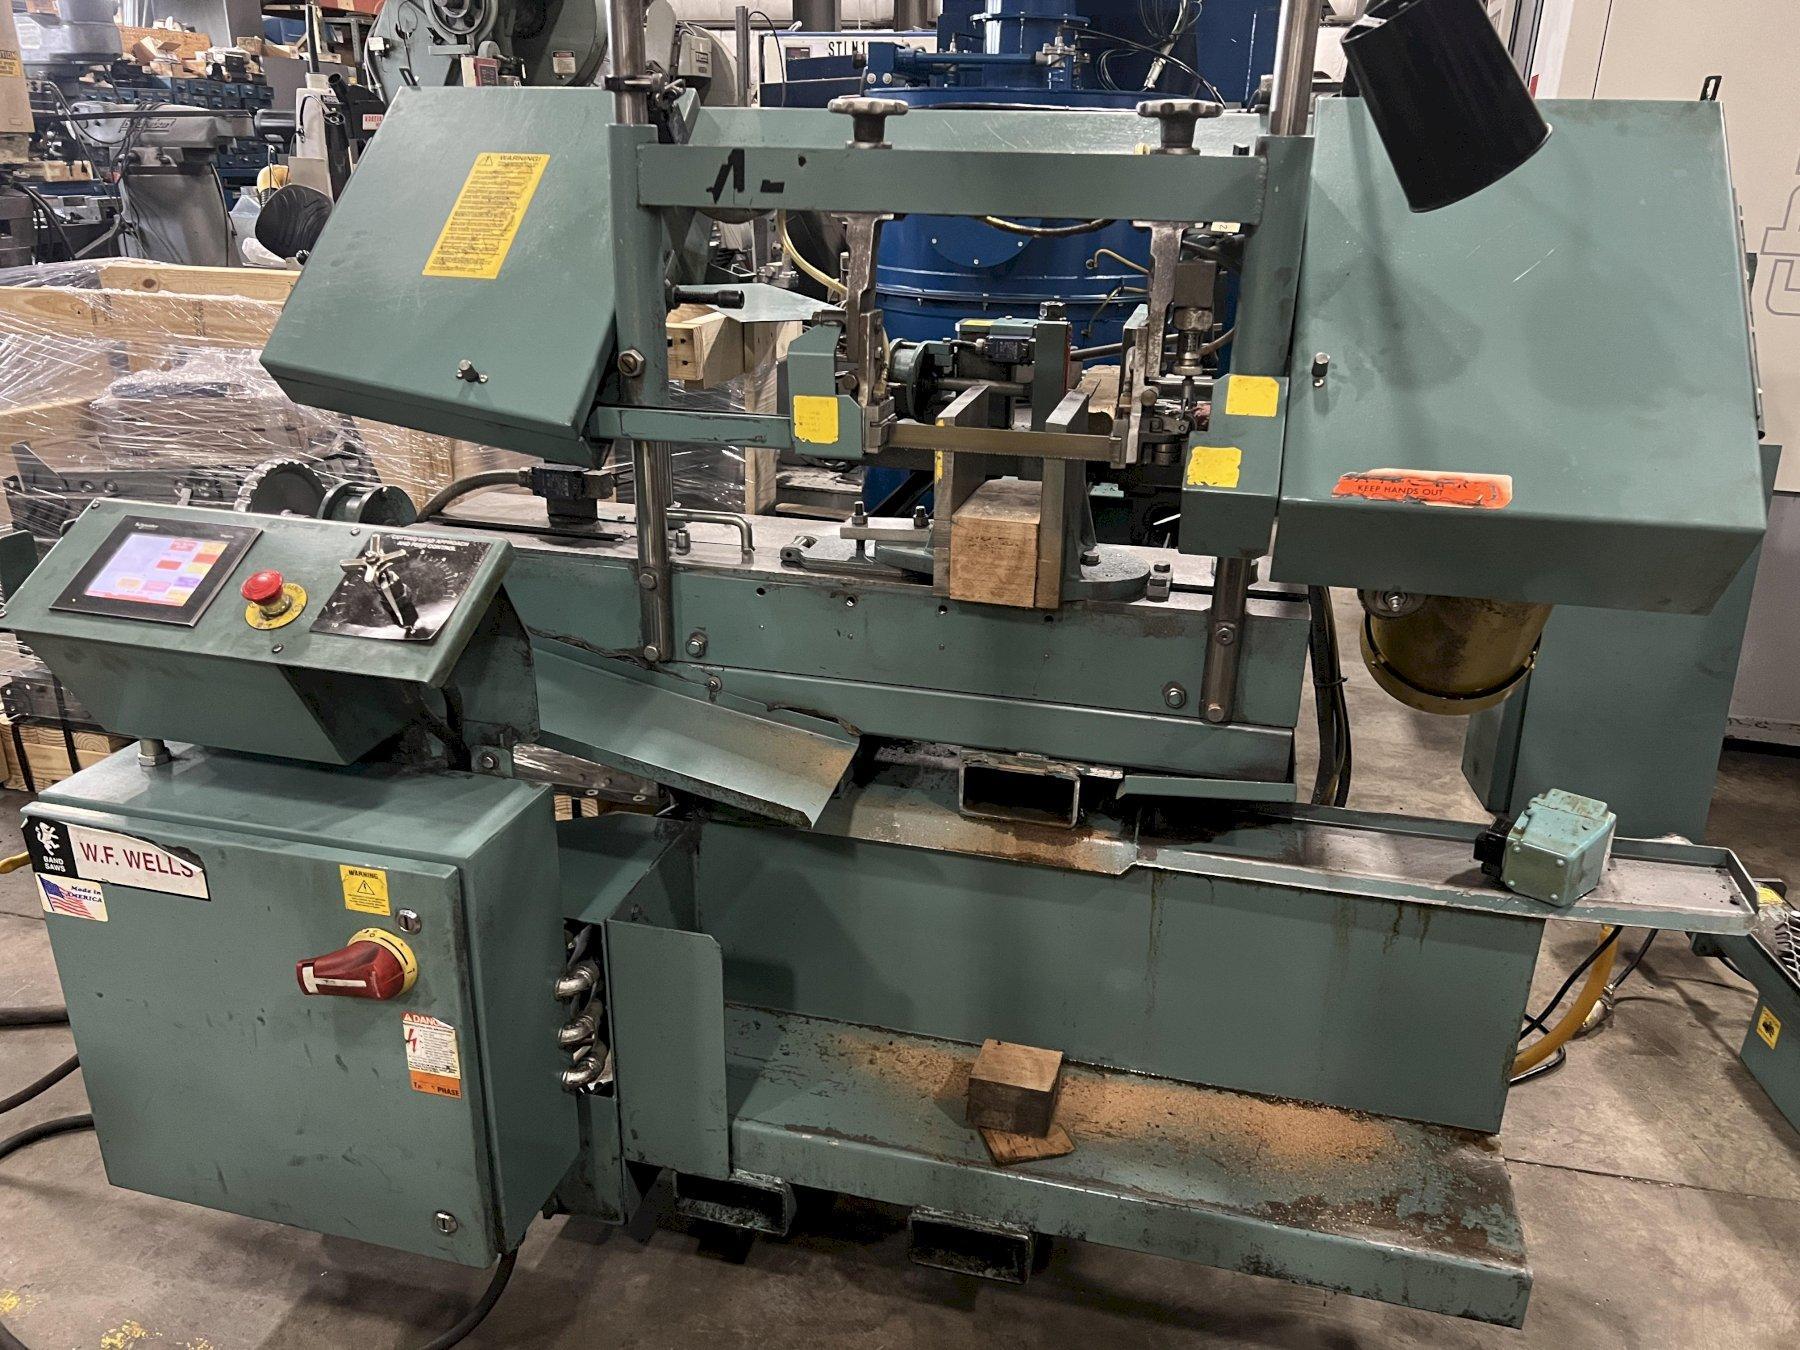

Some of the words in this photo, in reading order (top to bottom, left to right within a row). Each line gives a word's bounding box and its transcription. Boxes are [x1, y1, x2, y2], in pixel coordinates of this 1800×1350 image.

[1384, 486, 1419, 495] HANDS
[79, 842, 119, 866] W.F.
[43, 855, 64, 865] BAND
[44, 863, 66, 872] SAWS
[348, 870, 379, 879] WARNING
[71, 885, 92, 893] Made
[67, 891, 103, 903] AMERICA
[437, 1086, 461, 1097] PHASE
